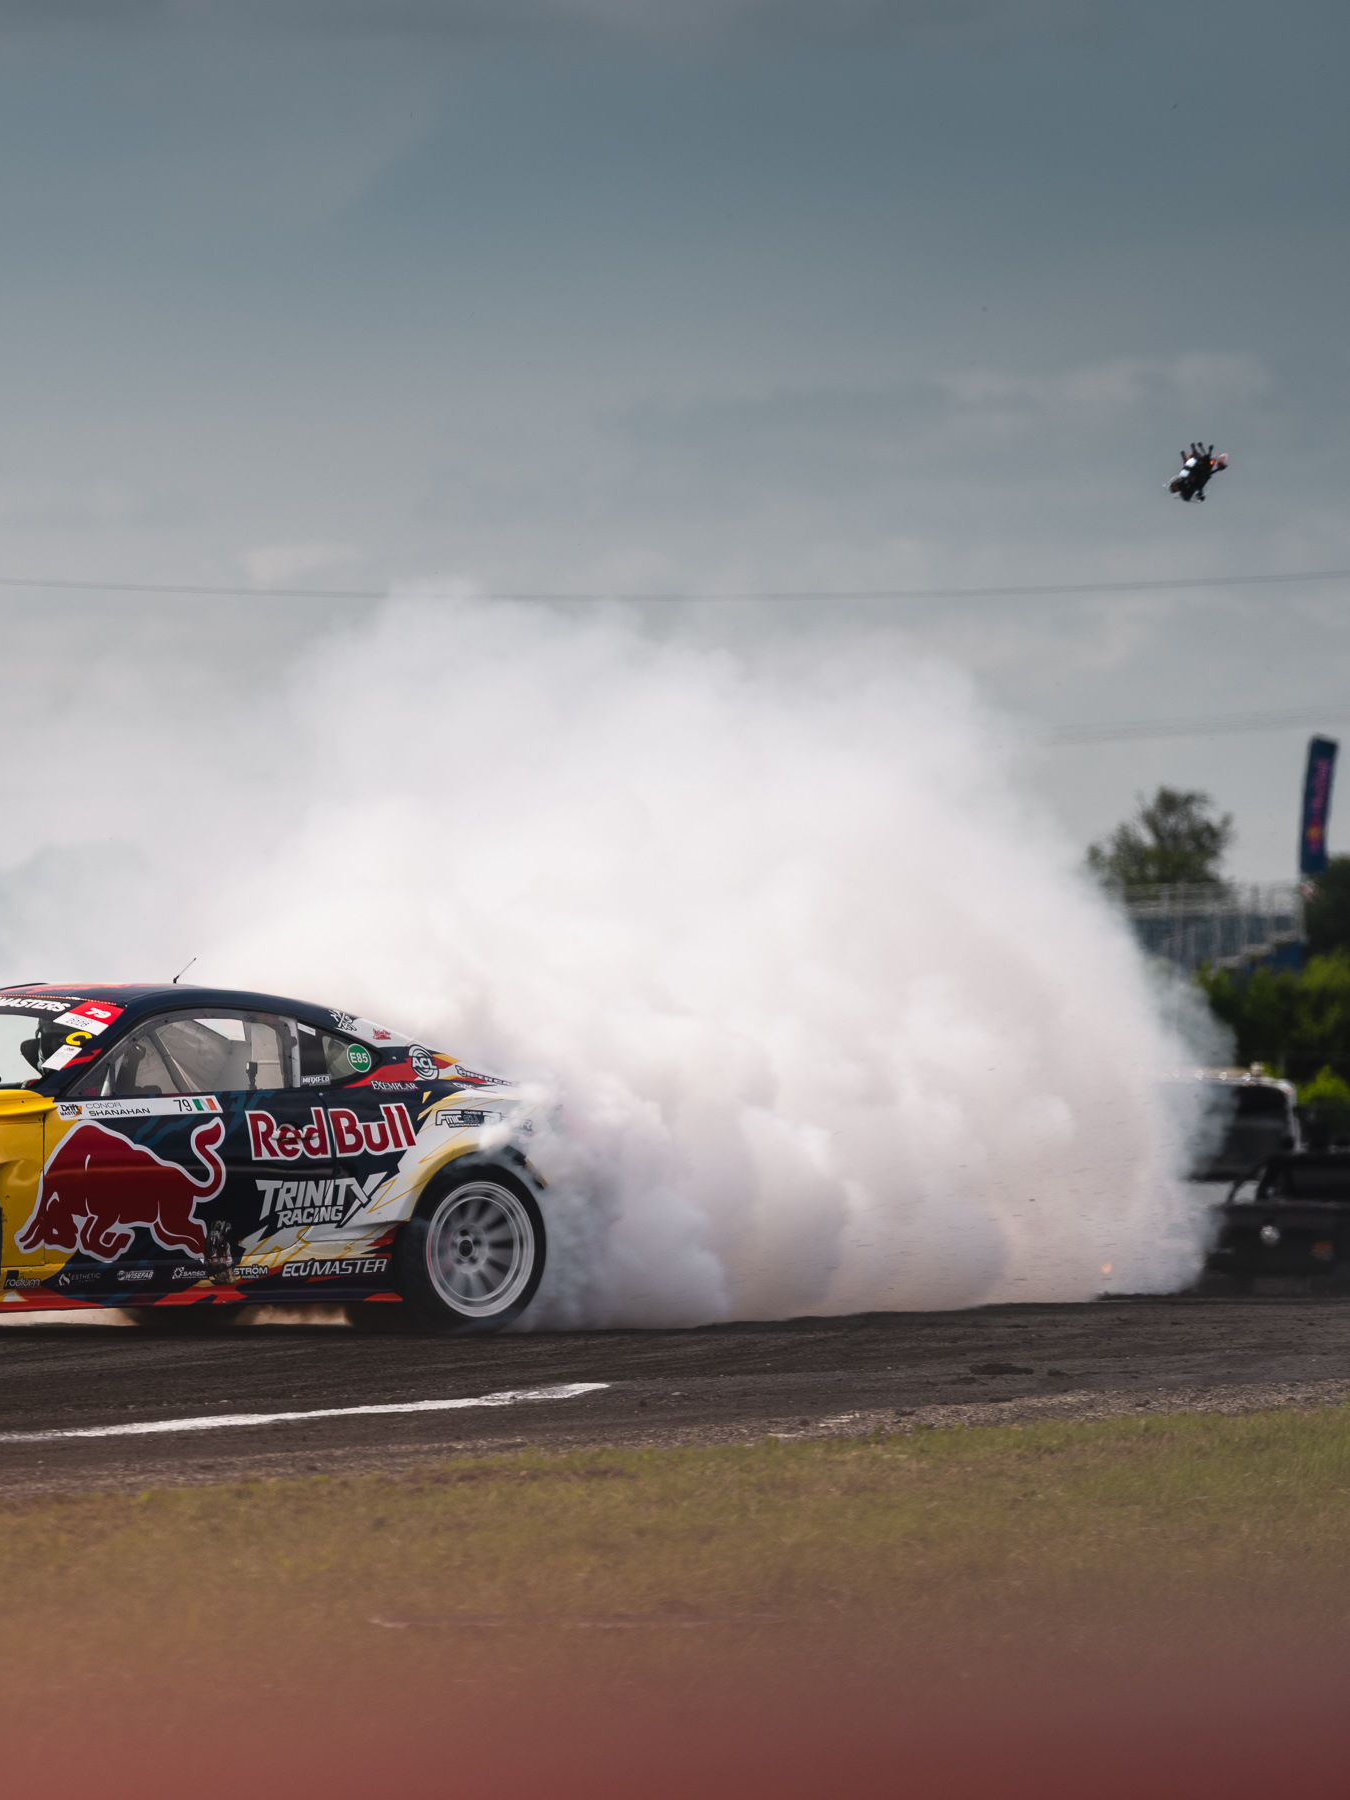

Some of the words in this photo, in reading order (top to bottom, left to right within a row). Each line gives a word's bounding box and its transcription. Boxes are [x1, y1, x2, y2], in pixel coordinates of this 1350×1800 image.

[85, 1007, 111, 1019] 79
[349, 1052, 368, 1064] E85
[412, 1057, 438, 1070] ACL
[173, 1099, 193, 1112] 79
[88, 1108, 150, 1117] SHANAHAN
[247, 1108, 330, 1159] Red
[329, 1104, 417, 1156] Bull
[255, 1172, 388, 1224] TRINITY
[277, 1206, 343, 1228] RACING
[126, 1270, 153, 1280] WISEFAB
[233, 1265, 268, 1276] STRÖM
[5, 1275, 40, 1287] radium
[71, 1273, 100, 1281] ESTHETIC
